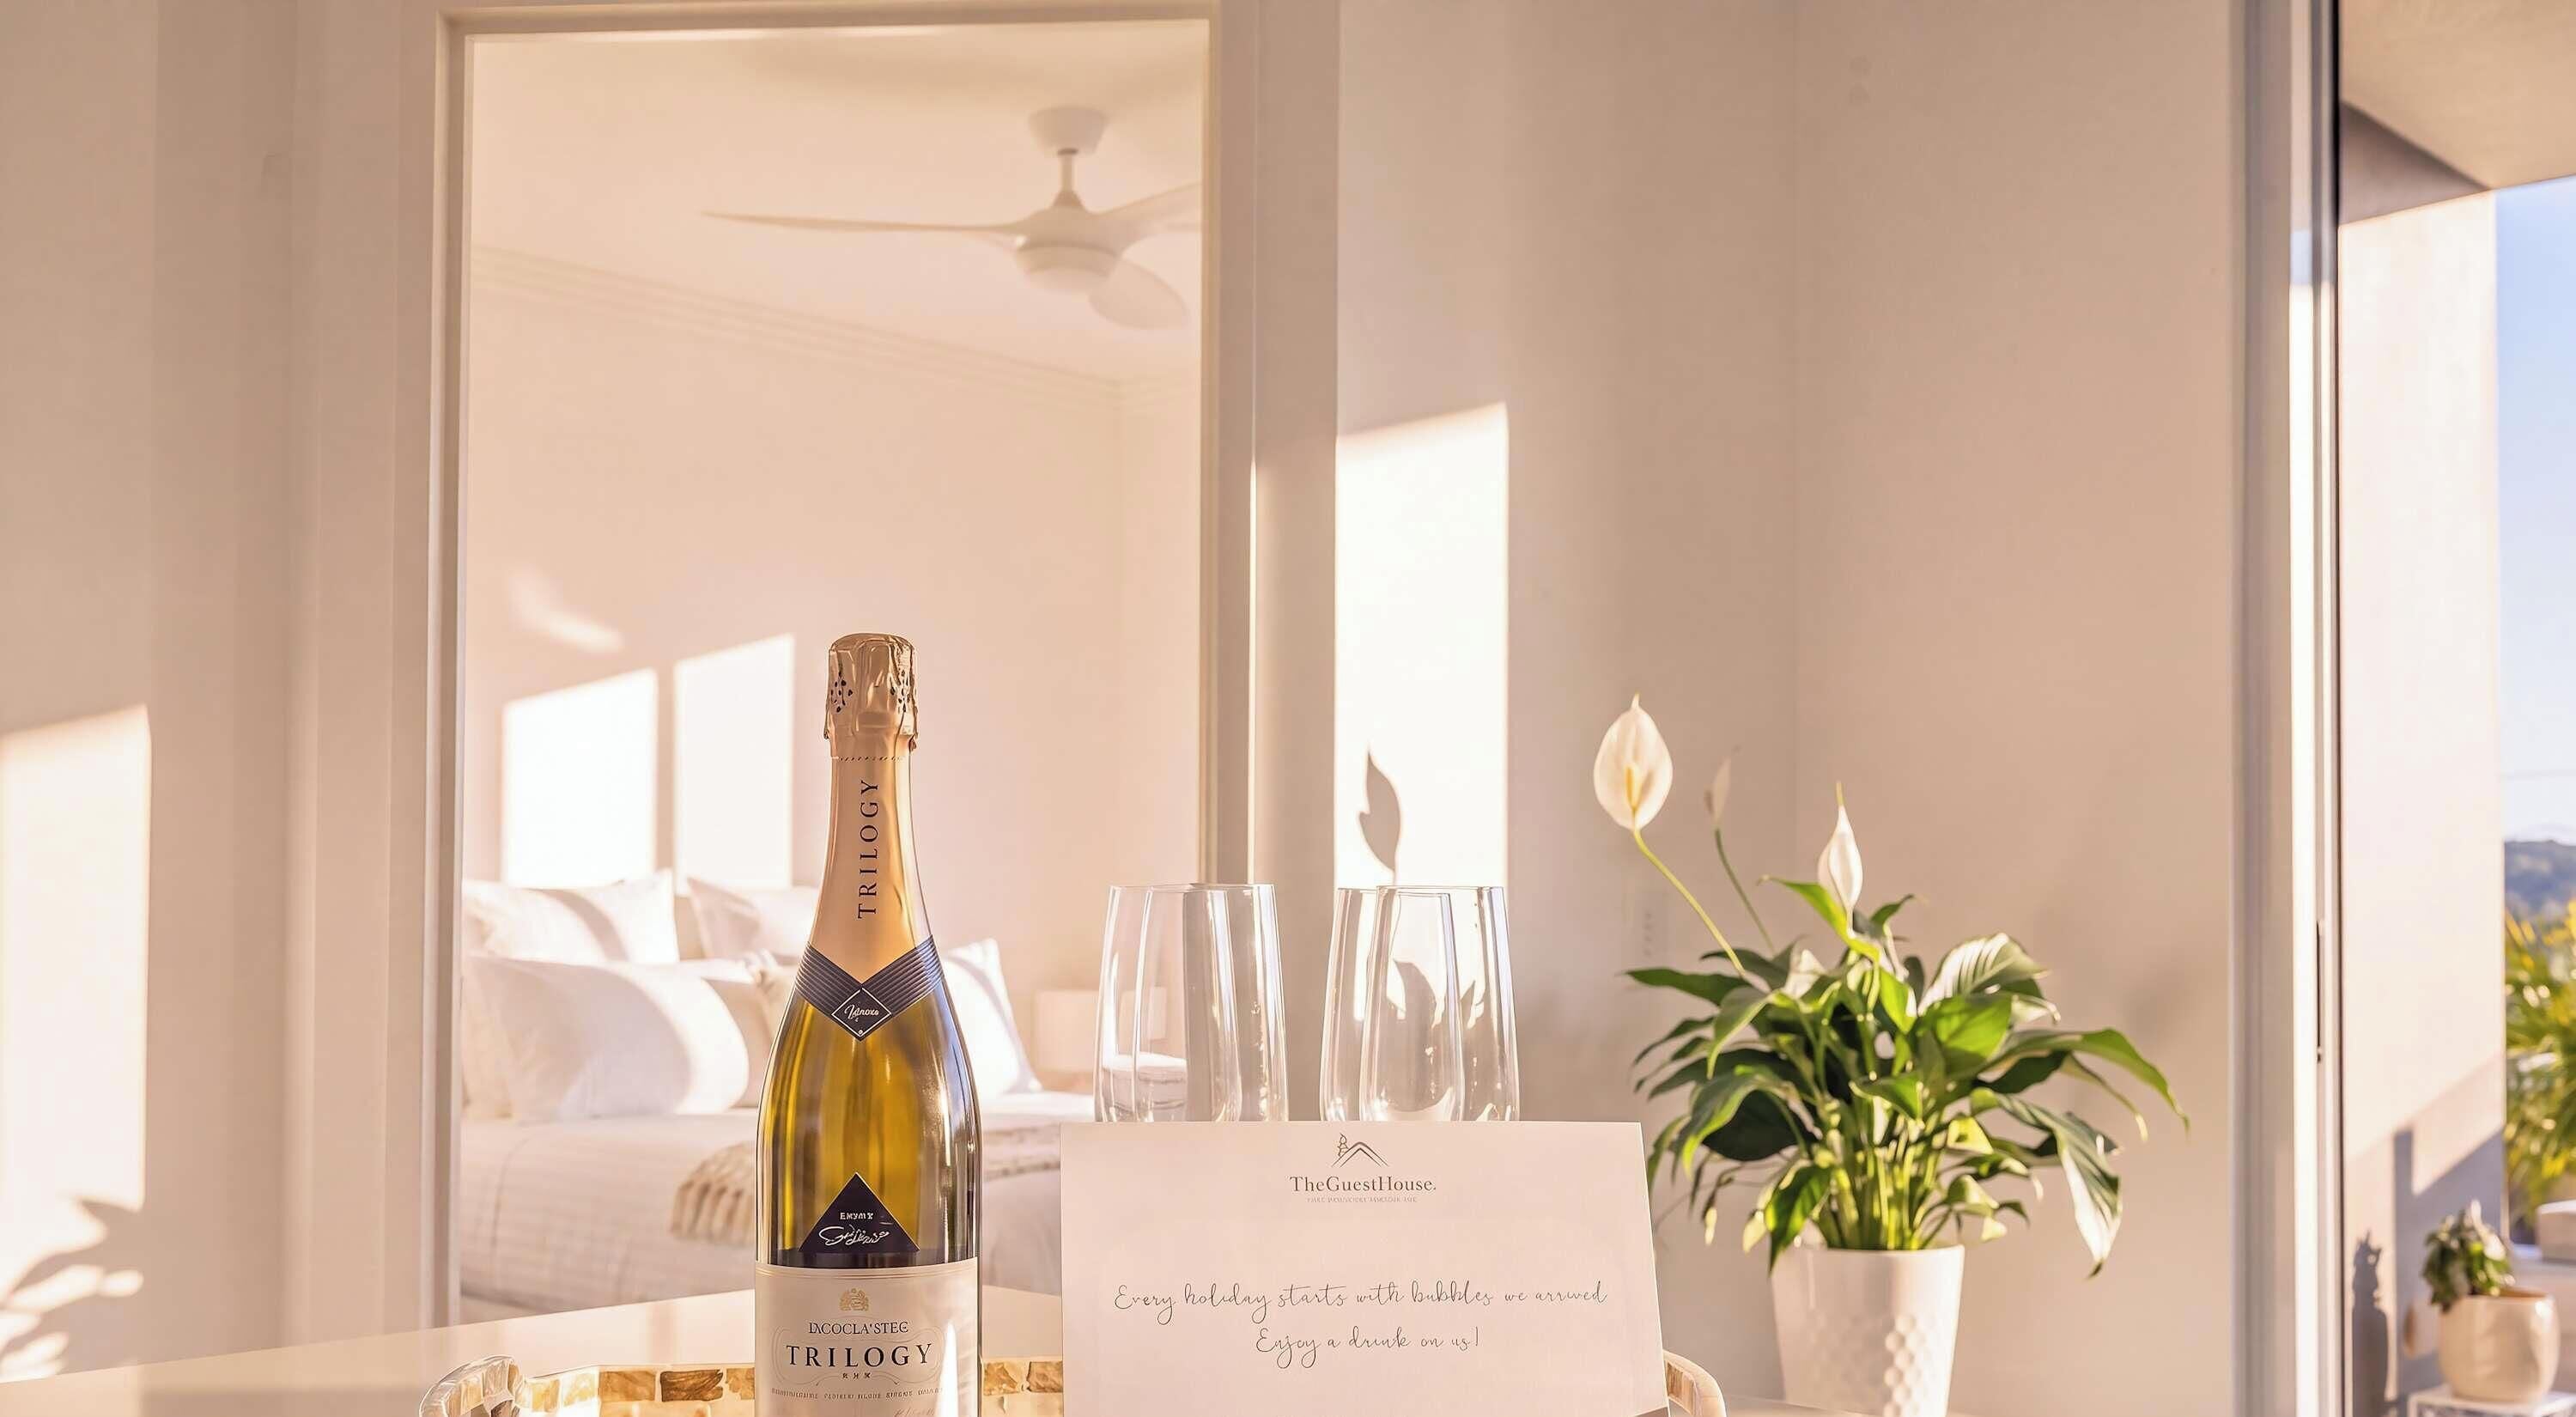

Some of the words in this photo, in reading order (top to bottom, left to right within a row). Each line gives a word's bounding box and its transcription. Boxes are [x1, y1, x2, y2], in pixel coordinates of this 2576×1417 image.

[857, 780, 879, 919] TRILOGY
[1115, 1285, 1176, 1325] Every
[1184, 1283, 1272, 1324] holiday
[1277, 1284, 1347, 1308] starts
[1356, 1281, 1404, 1305] with
[1411, 1280, 1493, 1305] bubbles
[1504, 1291, 1527, 1302] we
[786, 1343, 933, 1367] TRILOGY
[1255, 1328, 1321, 1369] Enjoy
[1327, 1338, 1341, 1348] a
[1420, 1335, 1443, 1347] on
